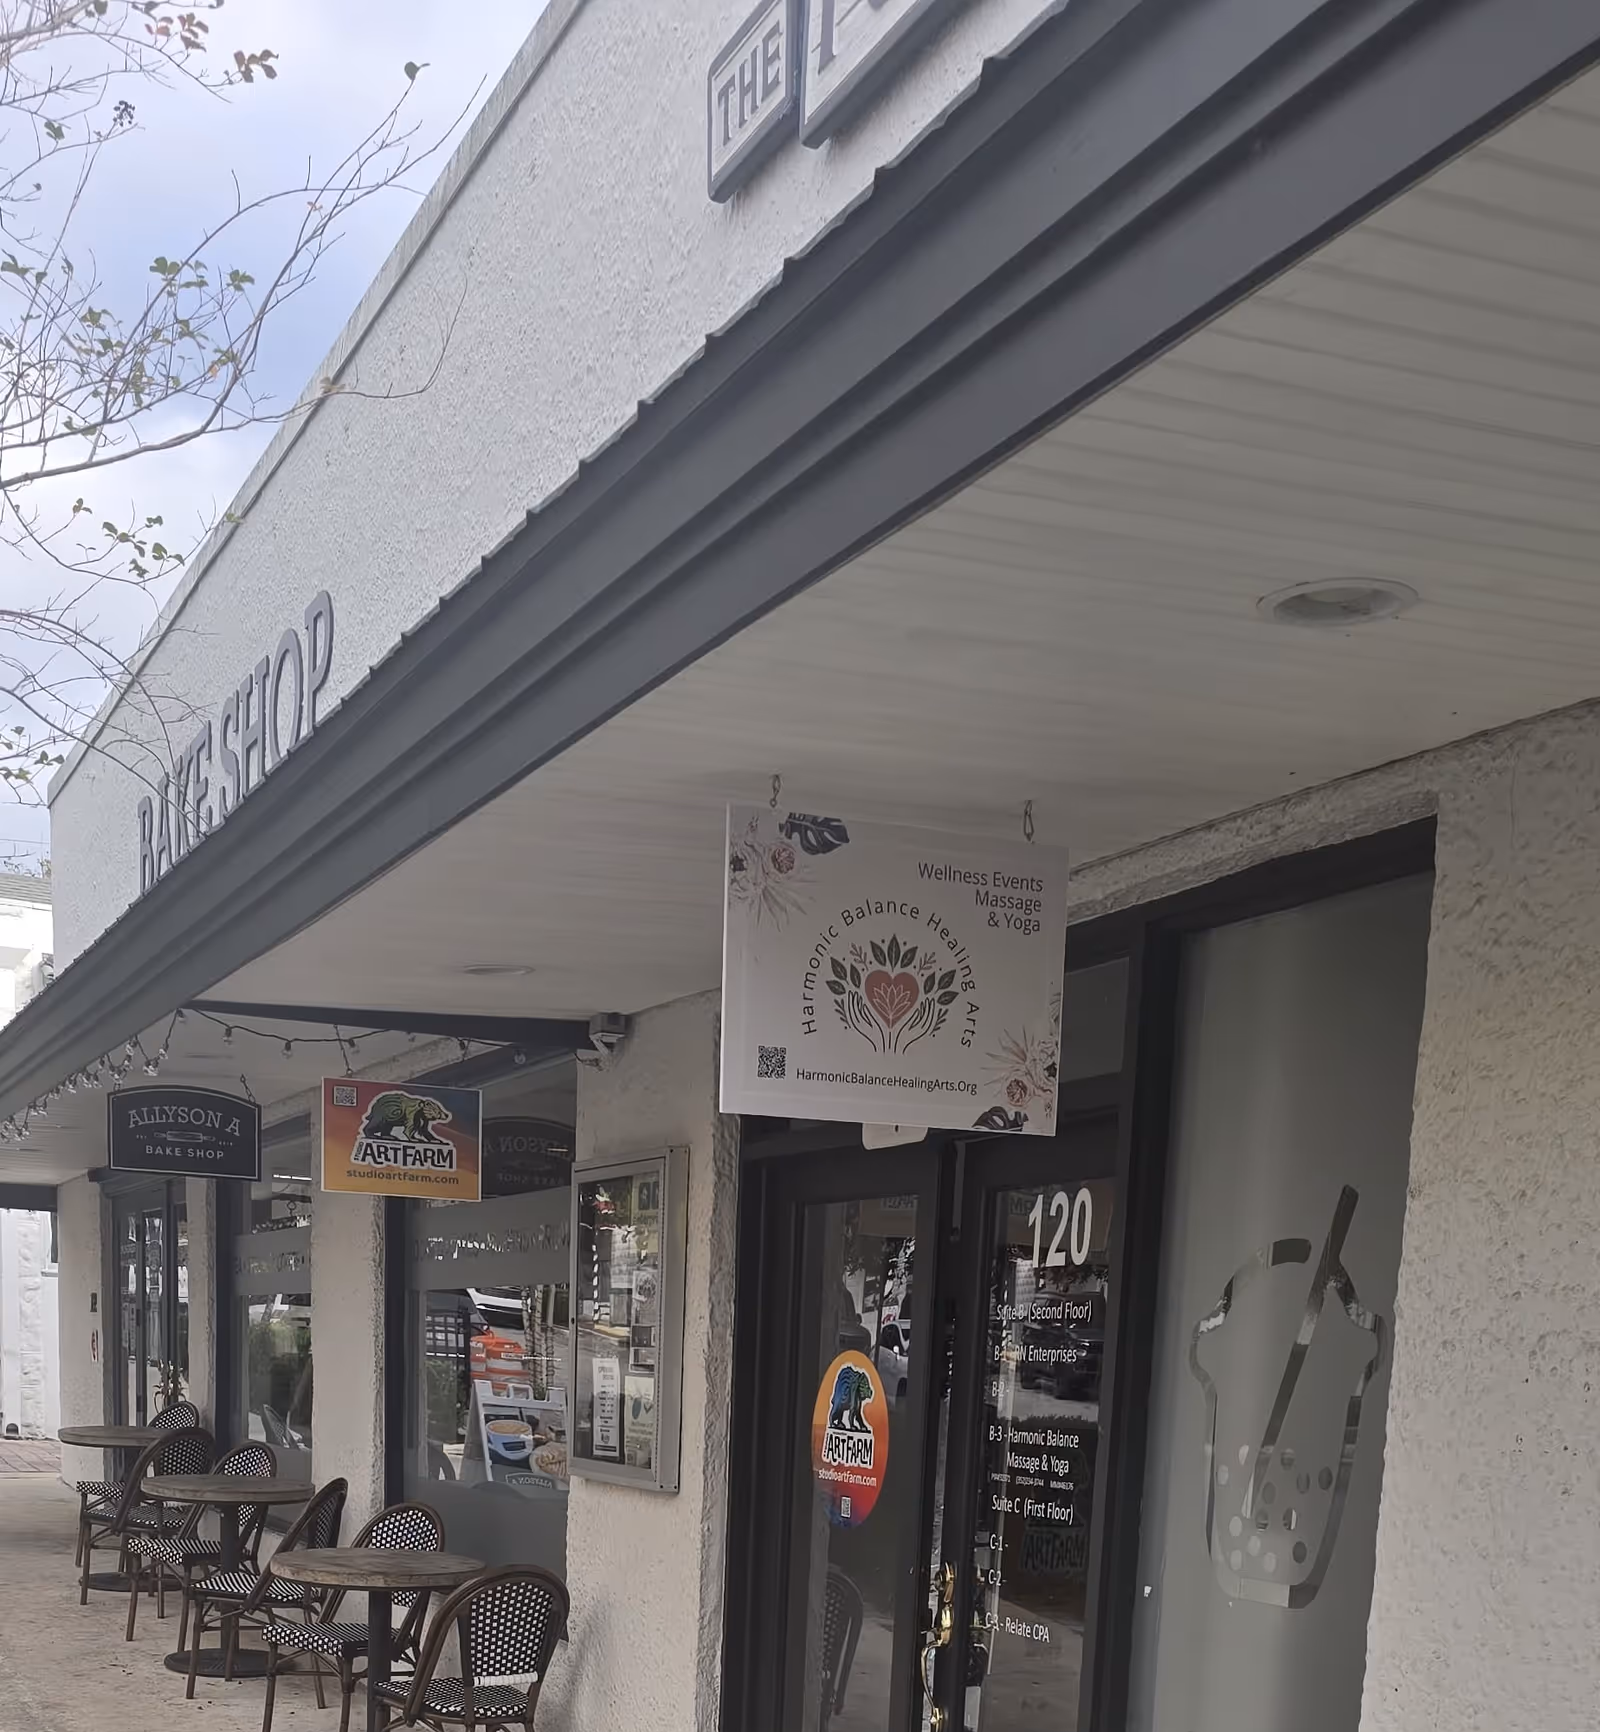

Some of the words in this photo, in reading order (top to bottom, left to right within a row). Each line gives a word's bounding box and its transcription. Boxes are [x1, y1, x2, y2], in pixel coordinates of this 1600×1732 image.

[717, 19, 783, 147] THE
[137, 719, 213, 897] BAKE
[219, 589, 334, 817] SHOP
[918, 861, 988, 887] Wellness
[993, 871, 1044, 893] Events
[975, 889, 1042, 916] Massage
[987, 912, 1001, 928] &
[1003, 913, 1041, 935] Yoga
[801, 924, 839, 1035] Harmonic
[841, 898, 920, 926] Balance
[926, 912, 977, 992] Healing
[961, 1001, 980, 1048] Arts
[796, 1067, 978, 1095] HarmonicBalanceHealingArts.Org
[128, 1105, 223, 1128] ALLYSON
[225, 1117, 241, 1136] A
[145, 1145, 182, 1157] BAKE
[187, 1148, 225, 1160] SHOP
[346, 1168, 460, 1185] studioartfarm.com
[1028, 1187, 1093, 1268] 120
[996, 1304, 1018, 1320] Suite
[1028, 1301, 1063, 1323] (Second
[1065, 1299, 1093, 1322] Floor)
[1028, 1345, 1078, 1366] Enterprises
[991, 1381, 1006, 1397] B-2
[988, 1425, 1004, 1442] B-3
[1007, 1427, 1046, 1447] Harmonic
[1046, 1429, 1080, 1449] Balance
[818, 1467, 877, 1487] studioartfarm.com
[1006, 1451, 1041, 1474] Massage
[1041, 1454, 1049, 1472] &
[1050, 1455, 1069, 1477] Yoga
[991, 1494, 1013, 1513] Suite
[1014, 1497, 1020, 1514] C
[1023, 1496, 1046, 1520] (First
[1047, 1501, 1075, 1526] Floor)
[989, 1533, 1004, 1552] C-1
[988, 1569, 1002, 1587] C-2
[1005, 1616, 1032, 1639] Relate
[1032, 1624, 1051, 1643] CPA
